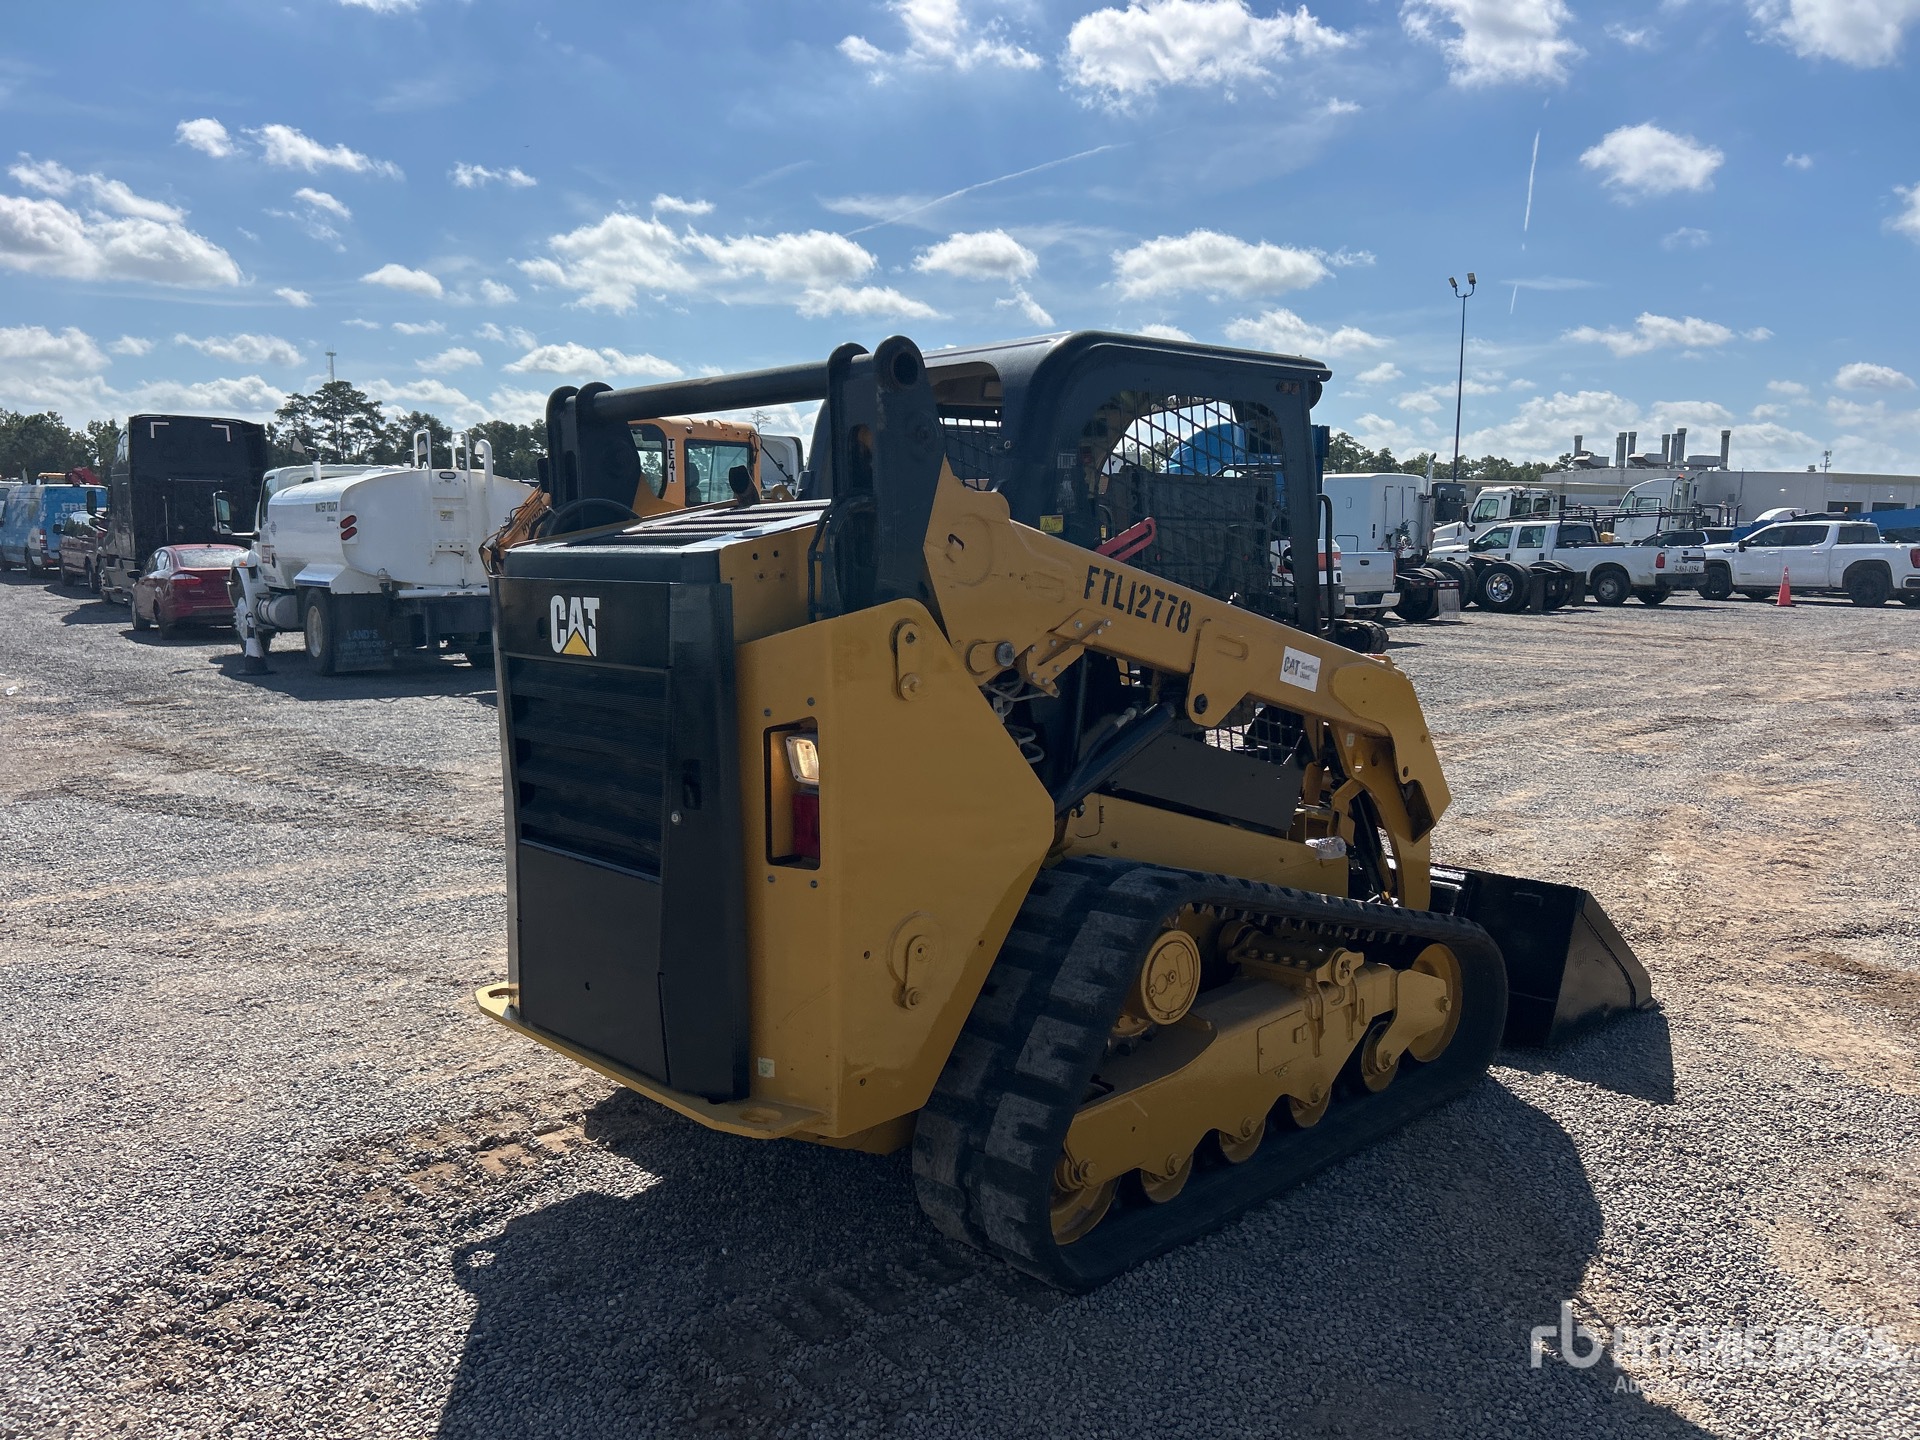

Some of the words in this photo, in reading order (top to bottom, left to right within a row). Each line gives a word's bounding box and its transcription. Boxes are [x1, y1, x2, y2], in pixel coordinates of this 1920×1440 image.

[667, 437, 676, 483] TE41
[551, 595, 600, 657] CAT
[1283, 656, 1300, 676] CAT
